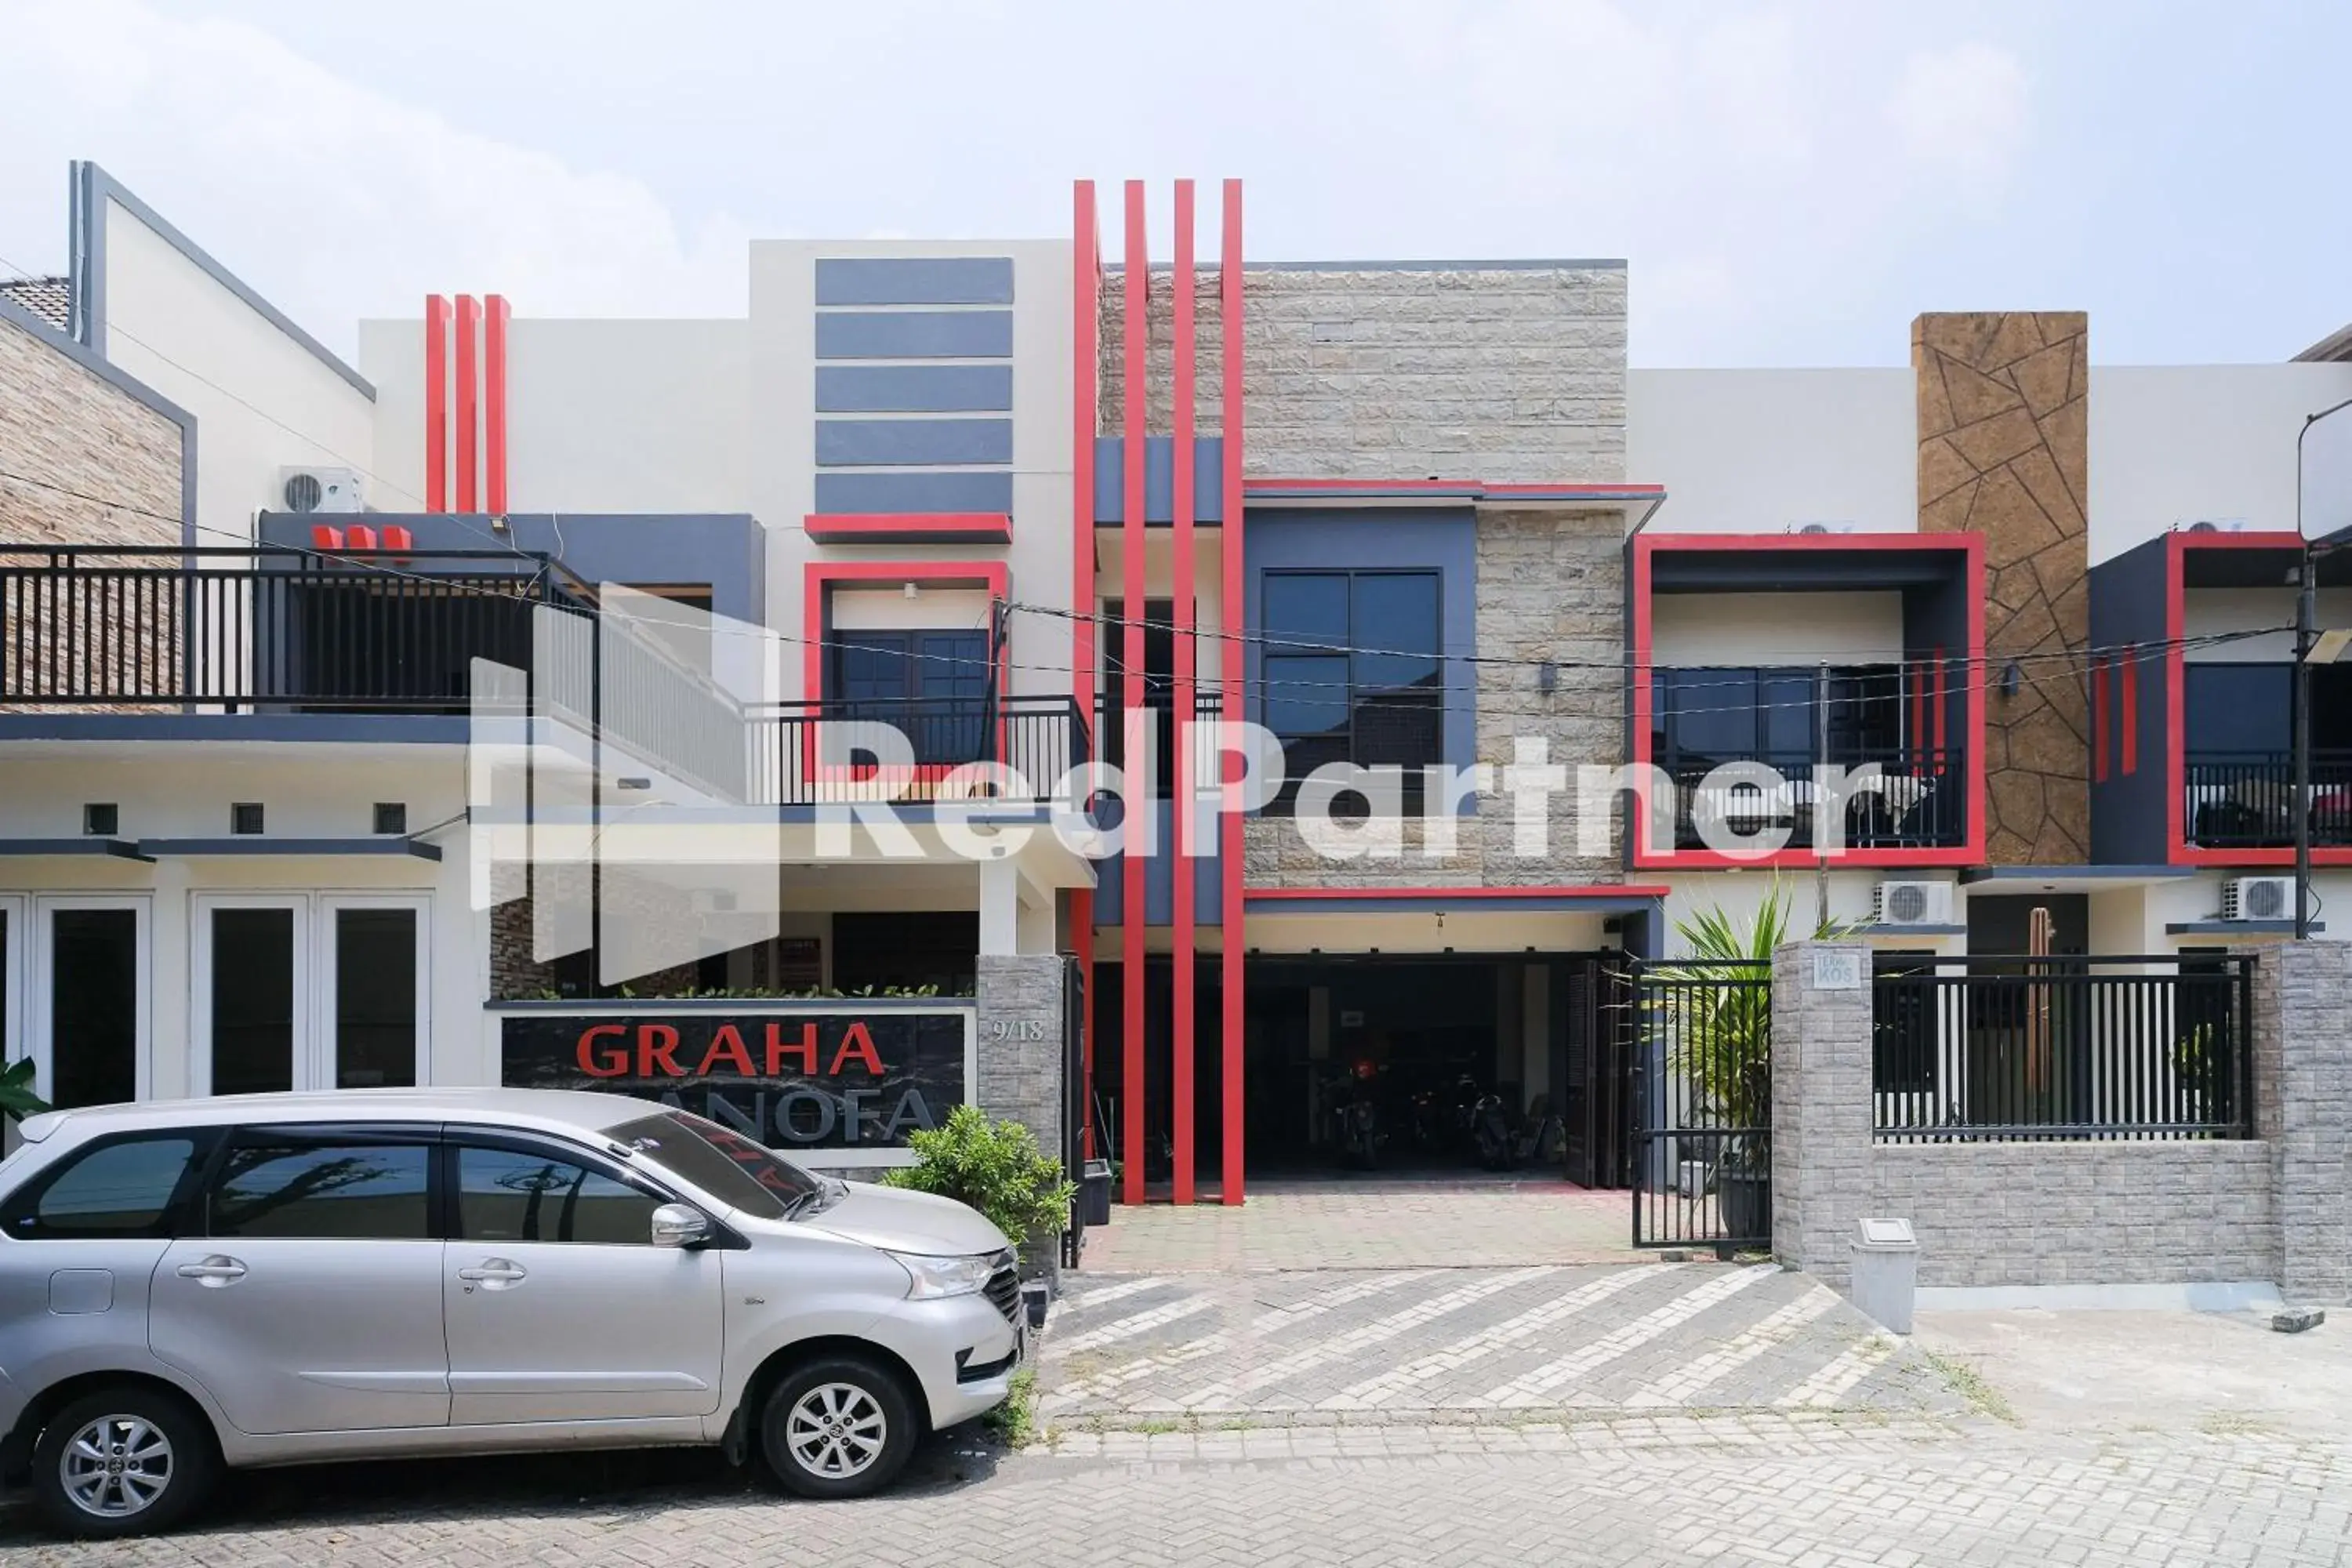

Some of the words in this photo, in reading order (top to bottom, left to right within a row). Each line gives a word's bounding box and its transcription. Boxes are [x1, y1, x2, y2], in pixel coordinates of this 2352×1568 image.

[1819, 967, 1853, 982] KOS
[993, 1020, 1044, 1041] 9/18
[576, 1022, 886, 1078] GRAHA
[659, 1088, 938, 1142] NOFA
